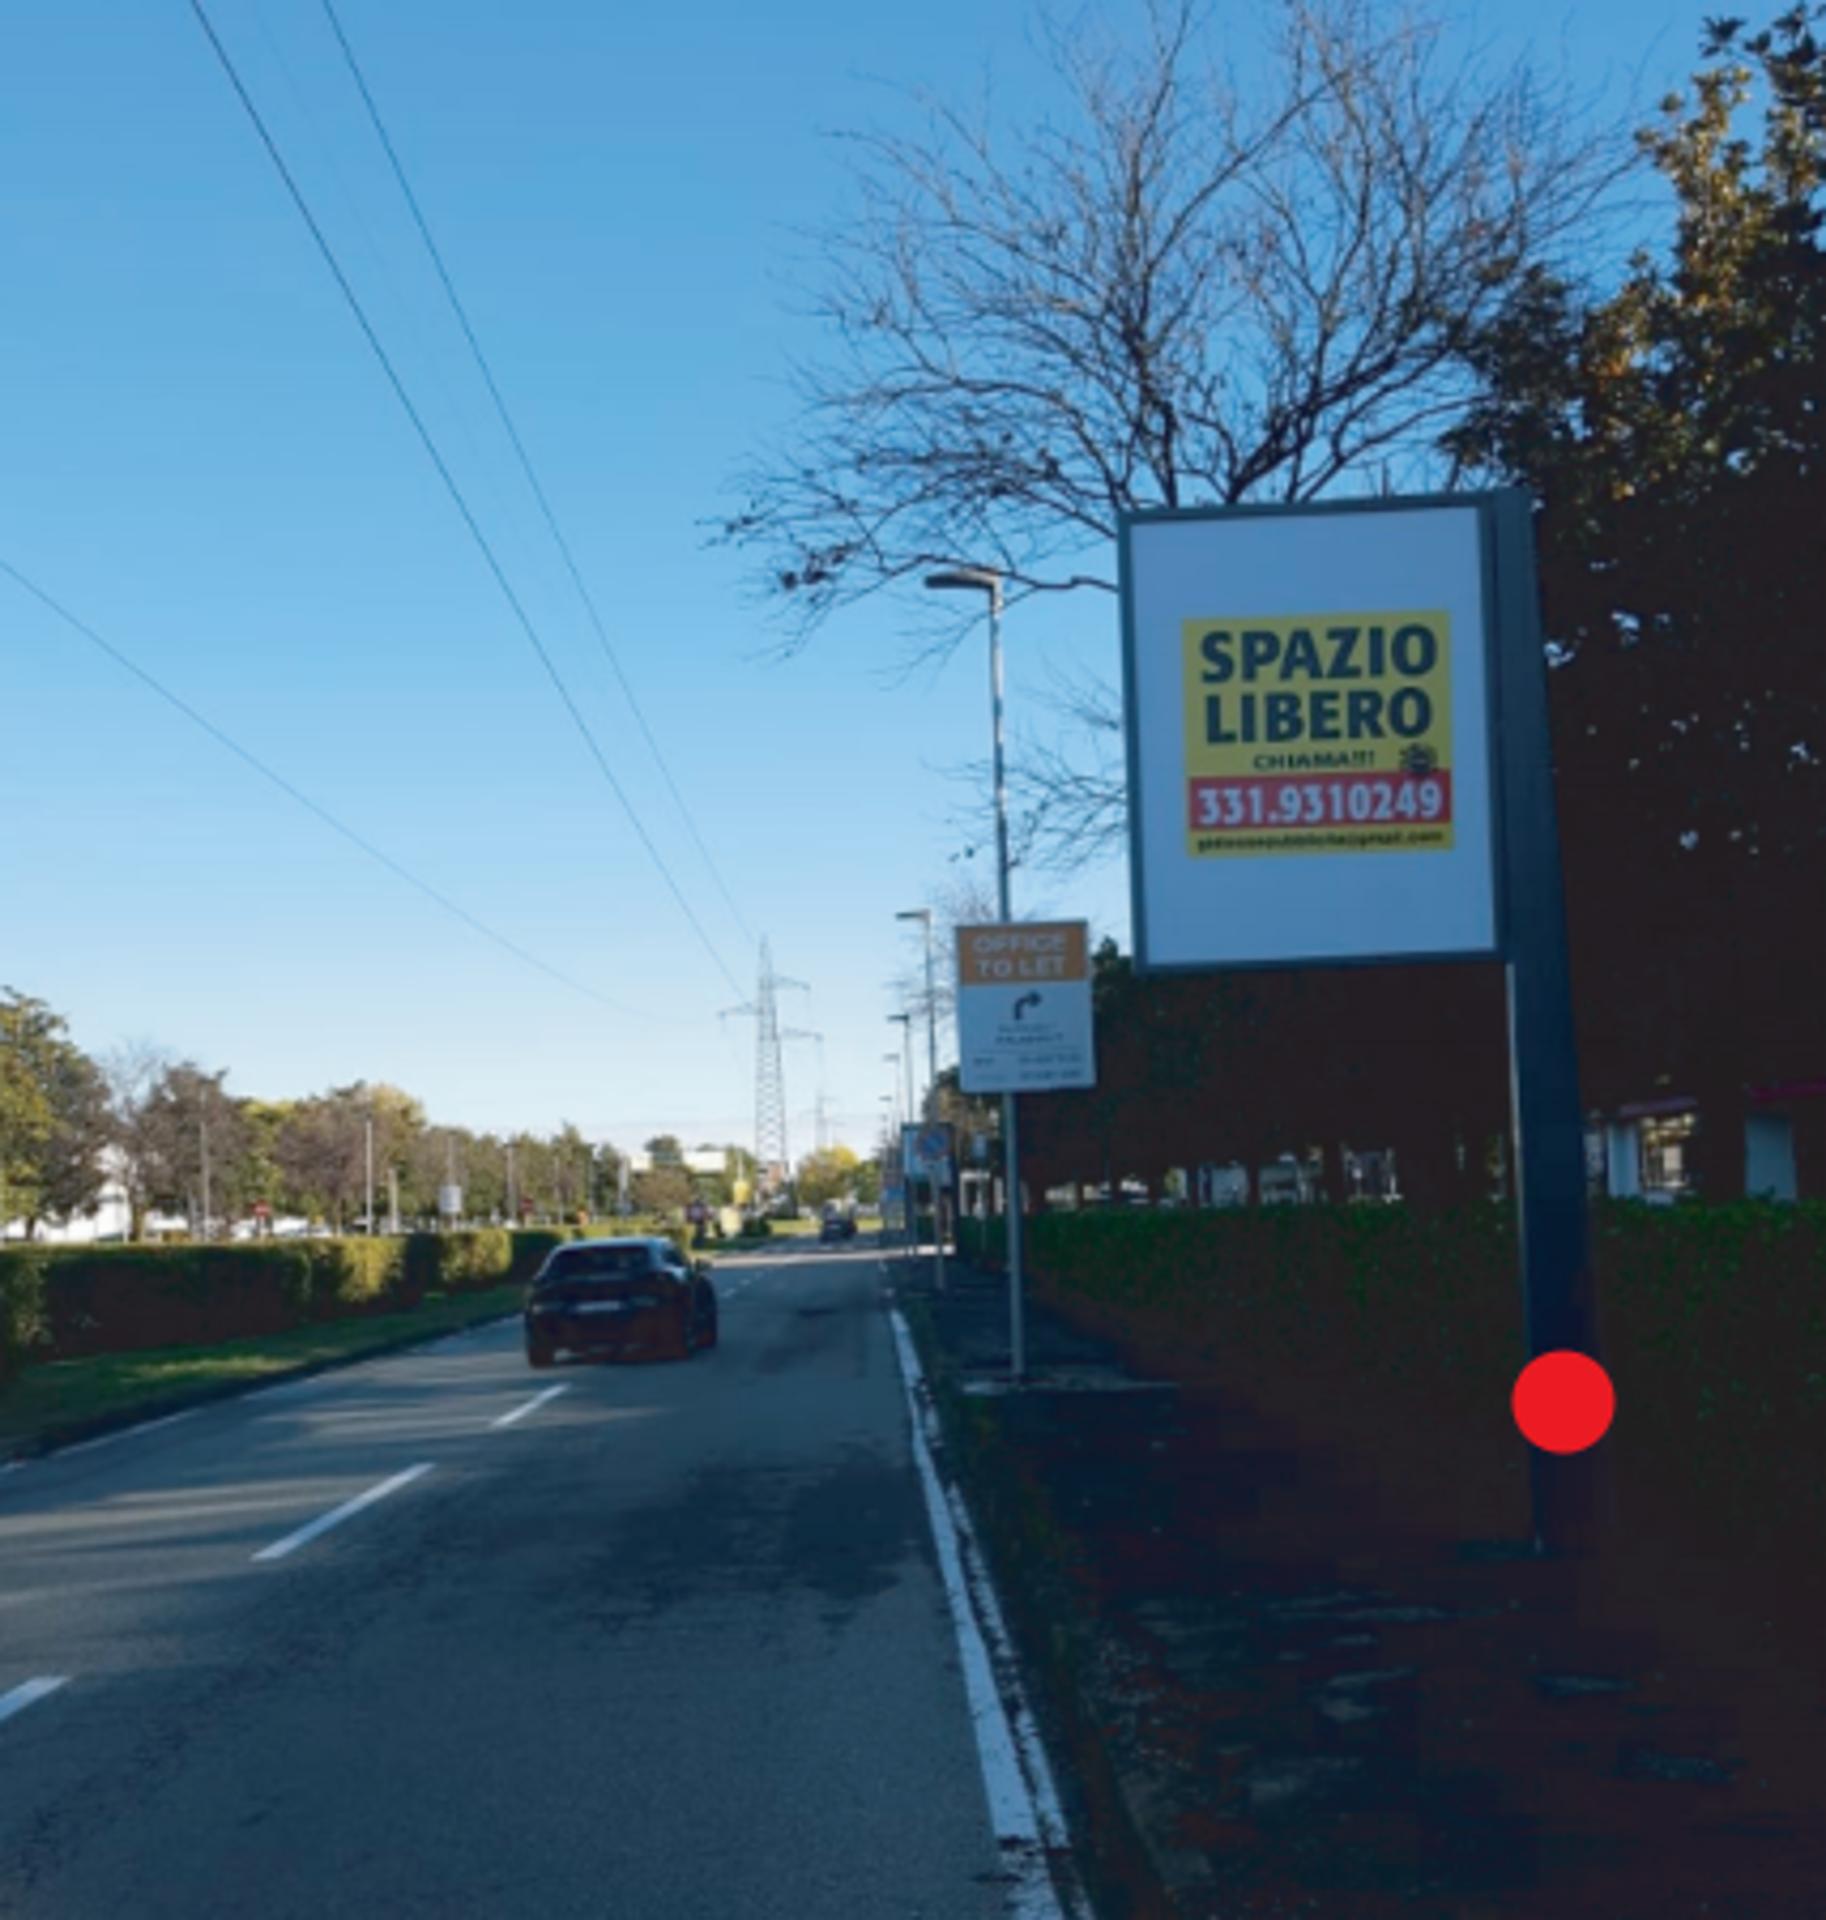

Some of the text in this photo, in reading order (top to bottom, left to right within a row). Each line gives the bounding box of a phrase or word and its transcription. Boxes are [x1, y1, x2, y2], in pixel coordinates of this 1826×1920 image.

[1200, 624, 1437, 683] SPAZIO
[1205, 686, 1432, 744] LIBERO
[1253, 750, 1375, 771] CHIAMA!!!
[1198, 781, 1443, 825] 331.9310249
[972, 932, 1065, 953] OFFICE
[976, 955, 1065, 978] TO LET
